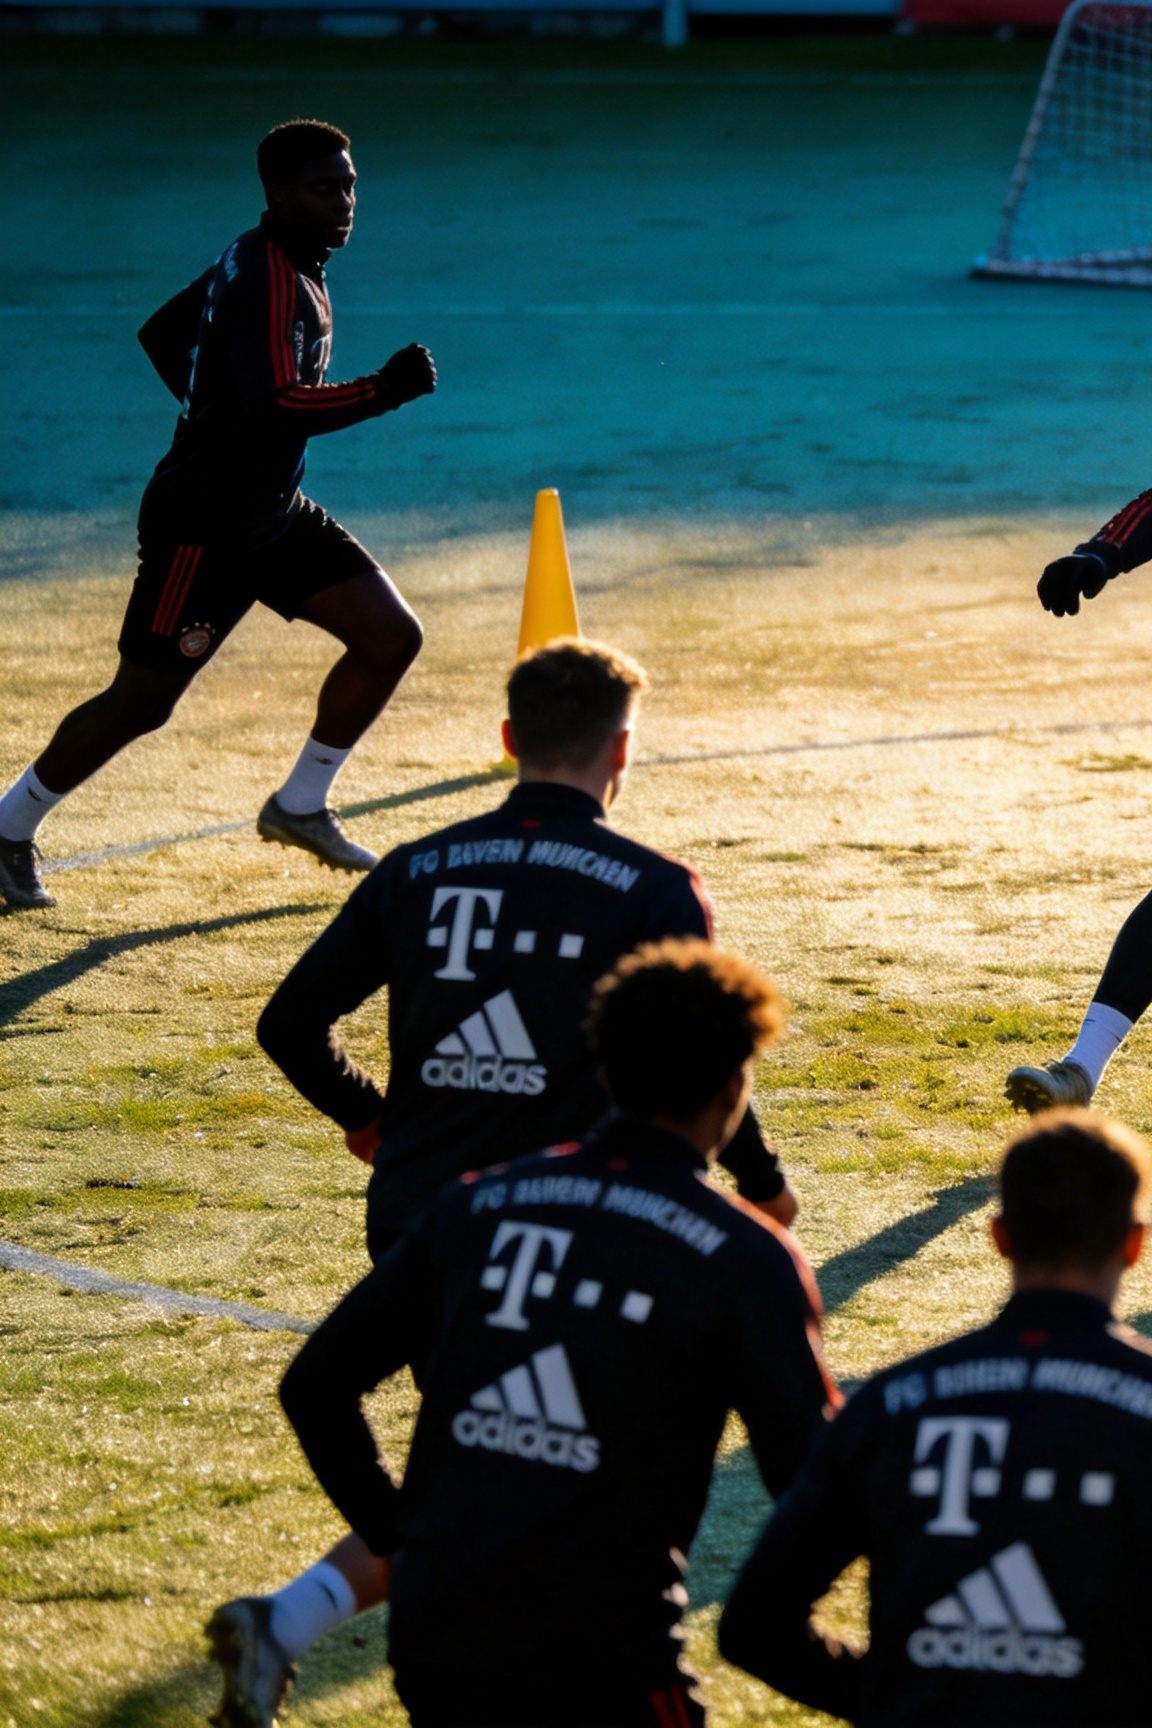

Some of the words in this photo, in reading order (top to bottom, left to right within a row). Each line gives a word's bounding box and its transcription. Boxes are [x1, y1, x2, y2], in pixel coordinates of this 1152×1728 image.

[421, 1055, 547, 1096] adidas
[452, 1409, 601, 1473] adidas
[906, 1627, 1084, 1679] adidas
